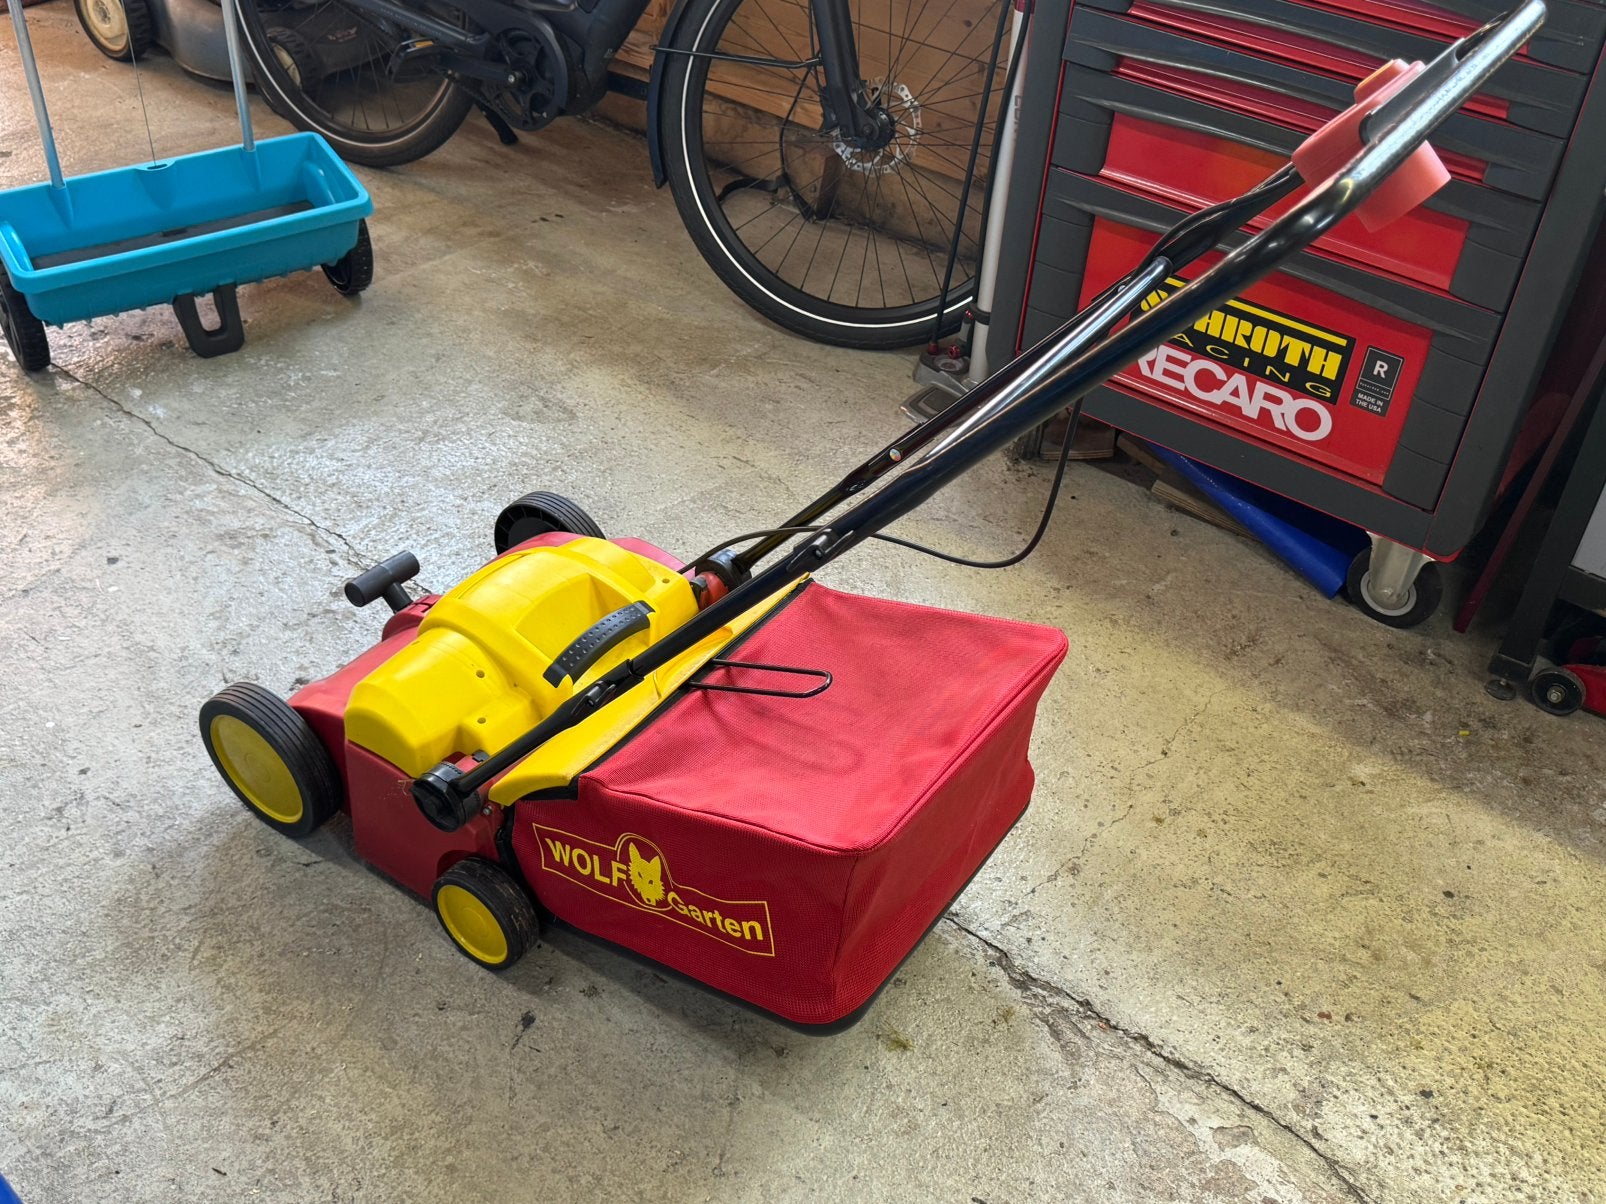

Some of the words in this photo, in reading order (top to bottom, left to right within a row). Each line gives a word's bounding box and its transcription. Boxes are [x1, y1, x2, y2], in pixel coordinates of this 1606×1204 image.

[1141, 289, 1342, 381] HROTH
[1170, 333, 1331, 398] ACING
[1373, 360, 1388, 378] R
[1356, 399, 1368, 408] THE
[1368, 403, 1382, 413] USA
[1358, 393, 1376, 403] MADE
[545, 838, 627, 887] WOLF
[667, 891, 763, 940] Garten
